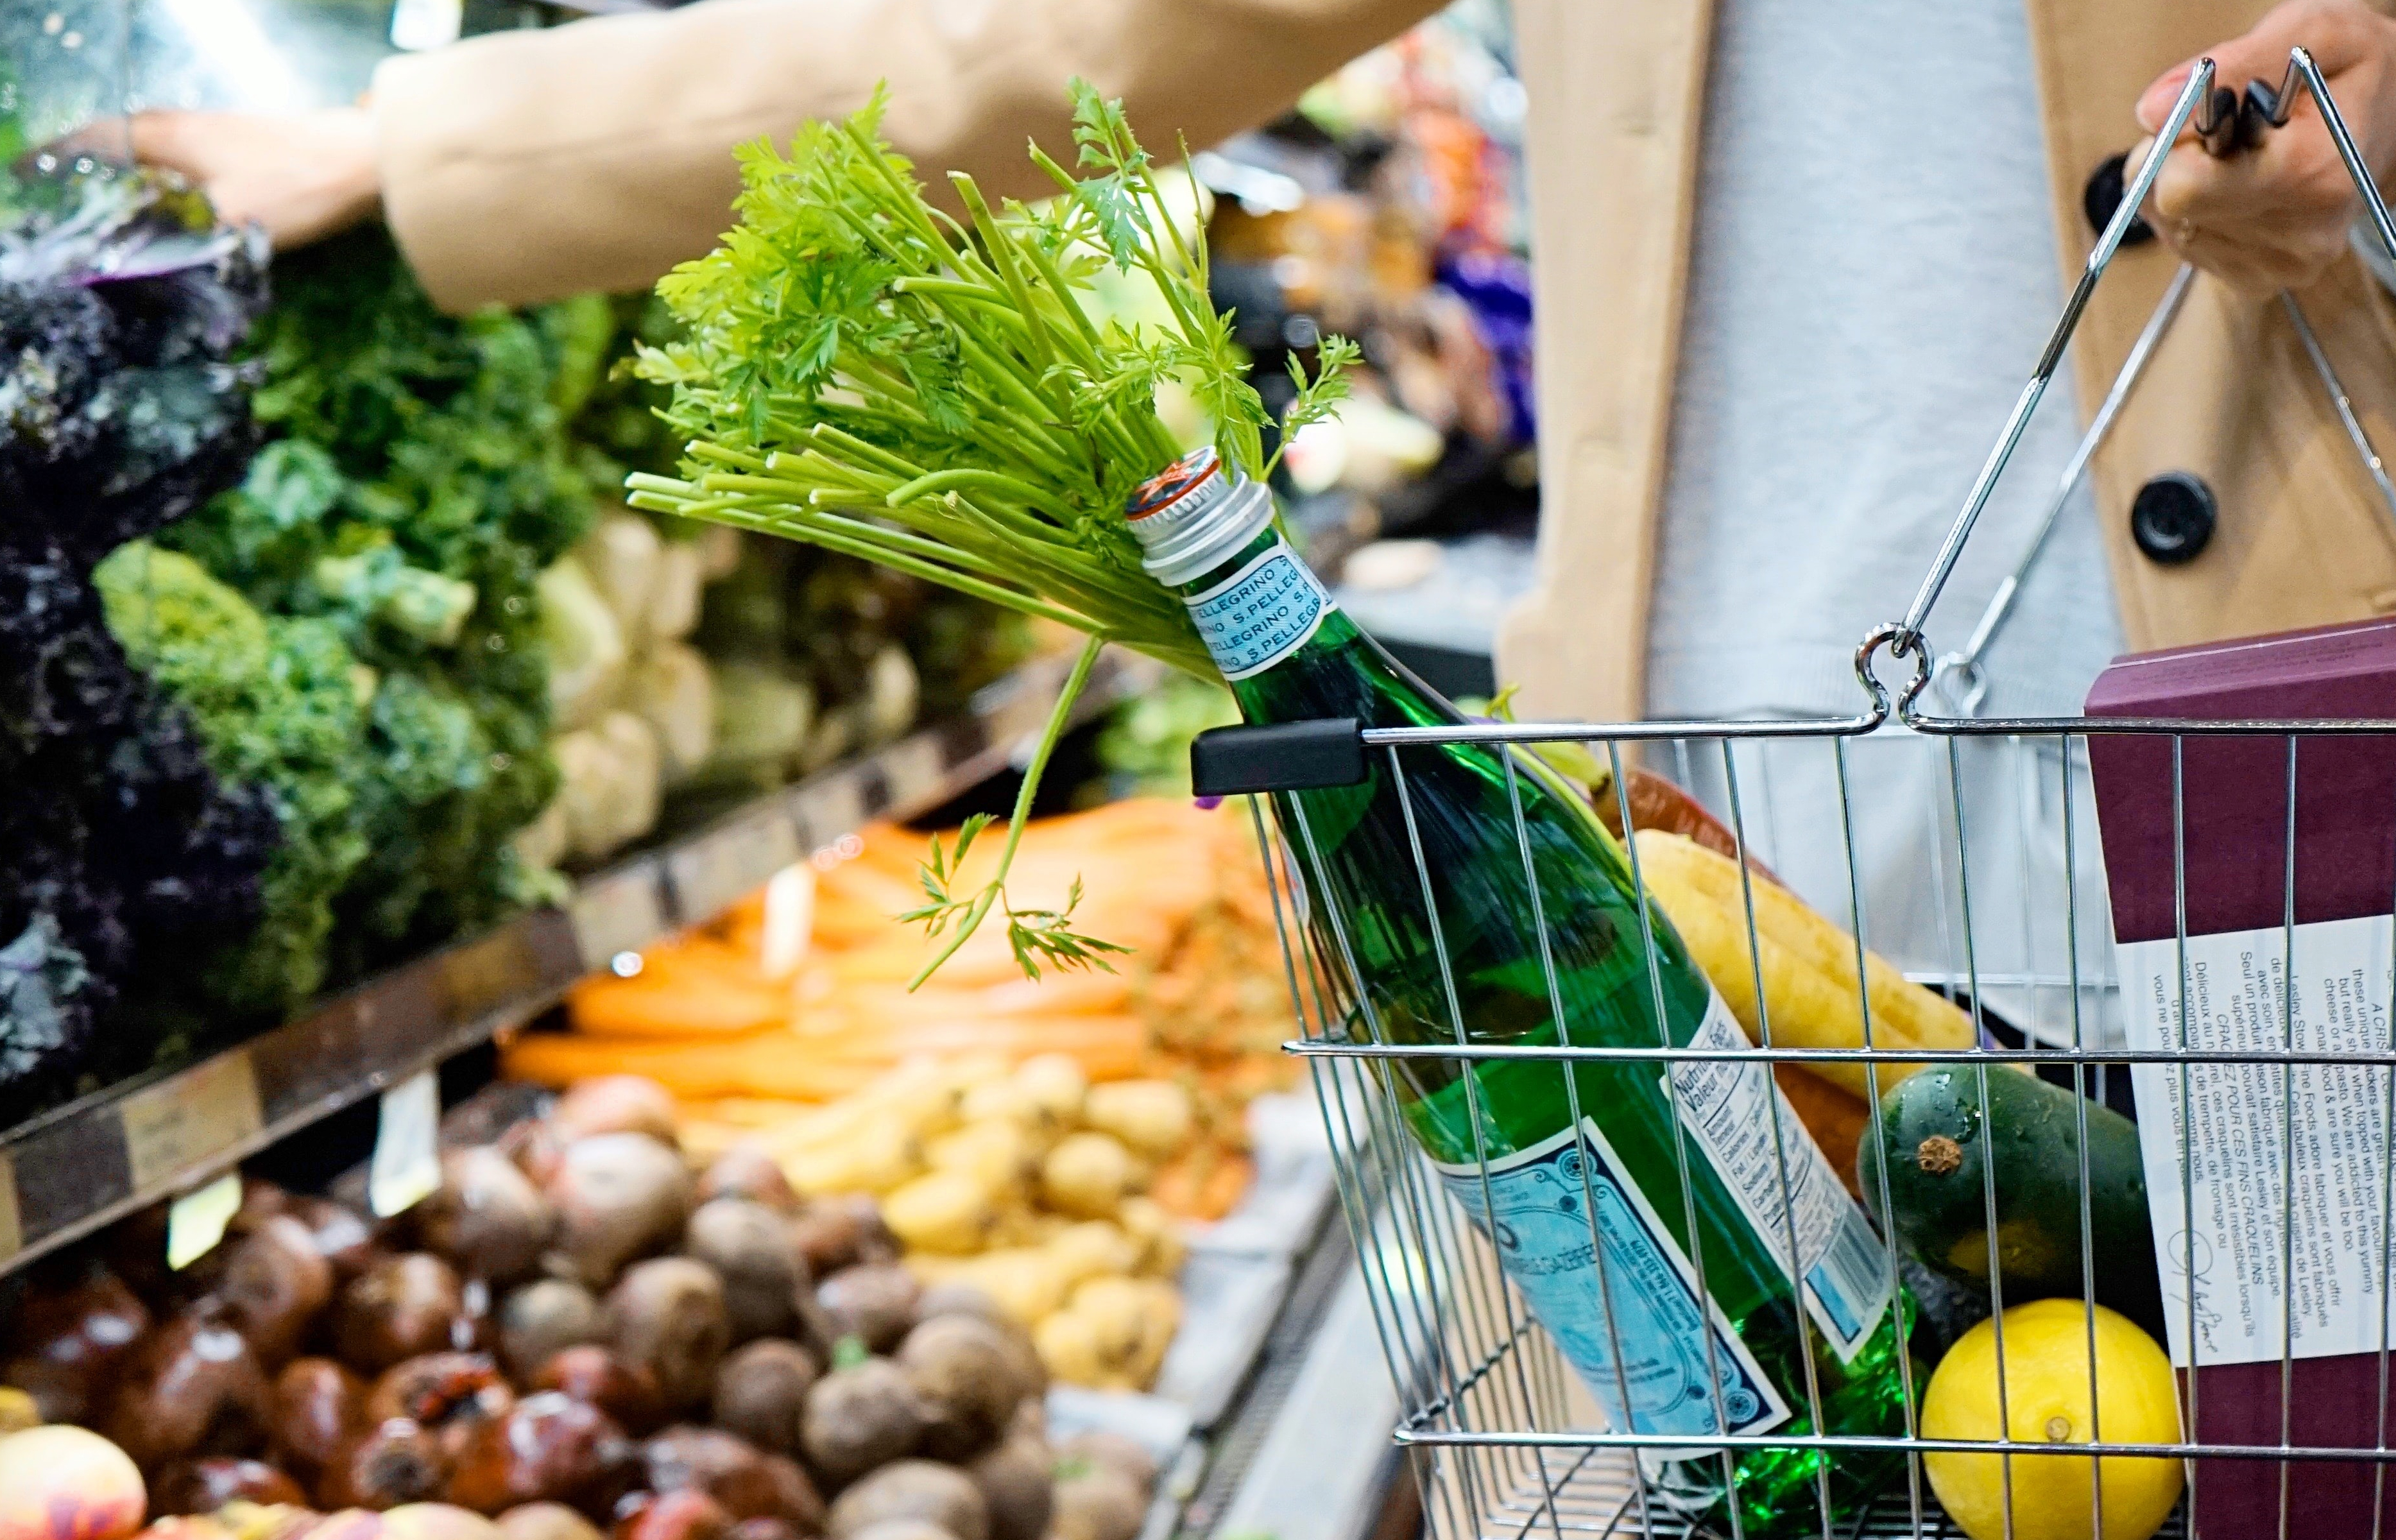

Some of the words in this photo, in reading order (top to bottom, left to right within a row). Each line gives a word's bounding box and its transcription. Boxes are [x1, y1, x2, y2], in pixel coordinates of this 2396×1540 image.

[2241, 951, 2255, 979] Seul
[2270, 957, 2283, 973] de
[2153, 973, 2165, 1004] vous
[2195, 962, 2212, 1018] Délicieux
[2245, 982, 2255, 999] un
[2257, 970, 2269, 999] avec
[2338, 977, 2350, 998] but
[2352, 968, 2366, 1003] these
[2323, 977, 2340, 1023] cheese
[2157, 1007, 2168, 1023] ne
[2245, 1002, 2264, 1046] produit
[2338, 1000, 2356, 1034] really
[2355, 1007, 2373, 1049] unique
[2202, 1022, 2212, 1038] au
[2266, 1036, 2276, 1052] en
[2330, 1027, 2340, 1040] or
[2195, 1075, 2207, 1091] de
[2238, 1064, 2257, 1109] pouvait
[2254, 1049, 2270, 1095] aison
[2269, 1056, 2284, 1096] etites
[2164, 1076, 2180, 1103] plus
[2212, 1090, 2223, 1113] ces
[2324, 1095, 2336, 1104] &
[2350, 1074, 2365, 1108] when
[2226, 1084, 2243, 1126] POUR
[2304, 1093, 2318, 1131] Foods
[2326, 1108, 2337, 1128] are
[2341, 1106, 2354, 1127] We
[2370, 1108, 2381, 1129] are
[2170, 1106, 2182, 1135] vous
[2257, 1096, 2277, 1147] fabriqué
[2353, 1111, 2371, 1154] topped
[2212, 1115, 2234, 1179] craquelins
[2232, 1128, 2247, 1158] CES
[2247, 1111, 2265, 1167] satisfaire
[2292, 1119, 2309, 1170] fabuleux
[2309, 1134, 2323, 1169] adore
[2329, 1132, 2341, 1159] sure
[2344, 1130, 2354, 1150] are
[2207, 1159, 2218, 1176] de
[2236, 1160, 2252, 1193] FINS
[2267, 1150, 2279, 1179] avec
[2331, 1163, 2345, 1185] you
[2362, 1156, 2375, 1181] with
[2252, 1170, 2271, 1211] Lesley
[2272, 1182, 2285, 1204] des
[2347, 1153, 2364, 1206] addicted
[2206, 1179, 2225, 1230] fromage
[2224, 1181, 2238, 1208] sont
[2297, 1174, 2318, 1238] craquelins
[2311, 1173, 2331, 1229] fabriquer
[2337, 1188, 2349, 1208] will
[2363, 1185, 2377, 1211] your
[2261, 1213, 2273, 1226] et
[2340, 1210, 2352, 1227] be
[2354, 1209, 2366, 1222] to
[2216, 1233, 2226, 1249] ou
[2241, 1195, 2264, 1286] CRAQUELINS
[2263, 1229, 2273, 1251] son
[2322, 1231, 2334, 1244] et
[2356, 1224, 2370, 1247] this
[2295, 1257, 2308, 1273] de
[2308, 1240, 2322, 1267] sont
[2323, 1246, 2335, 1276] vous
[2357, 1250, 2374, 1295] yummy
[2309, 1270, 2331, 1328] fabriqués
[2328, 1279, 2342, 1308] offrir
